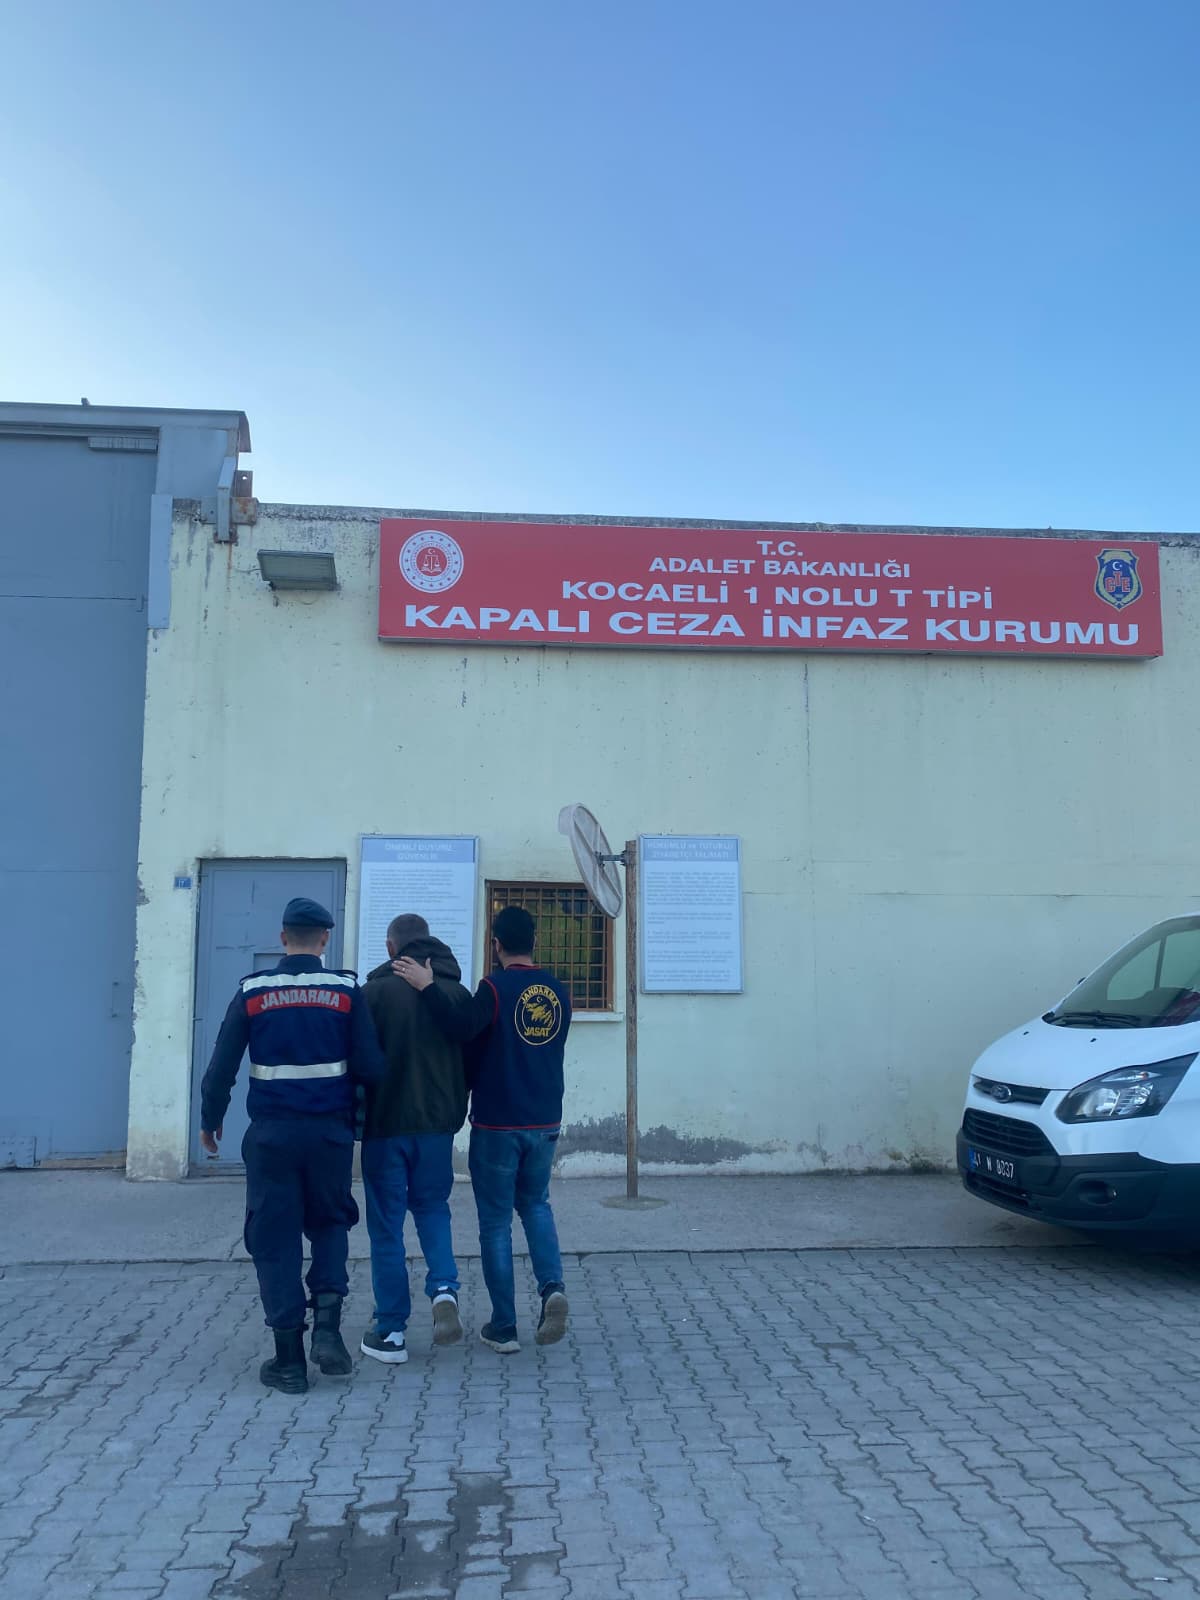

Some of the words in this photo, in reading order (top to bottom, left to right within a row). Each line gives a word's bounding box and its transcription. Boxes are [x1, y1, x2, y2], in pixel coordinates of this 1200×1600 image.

[756, 540, 804, 557] T.C.
[648, 557, 756, 574] ADALET
[763, 559, 910, 578] BAKANLIĞI
[562, 580, 729, 604] KOCAELİ
[743, 586, 758, 604] 1
[775, 586, 878, 607] NOLU
[889, 589, 913, 607] T
[922, 585, 993, 609] TİPİ
[405, 604, 590, 633] KAPALI
[608, 611, 746, 637] CEZA
[762, 608, 909, 640] İNFAZ
[925, 618, 1139, 646] KURUMU
[260, 989, 340, 1010] JANDARMA
[521, 986, 559, 1008] JANDARMA
[524, 1026, 552, 1037] JASAT
